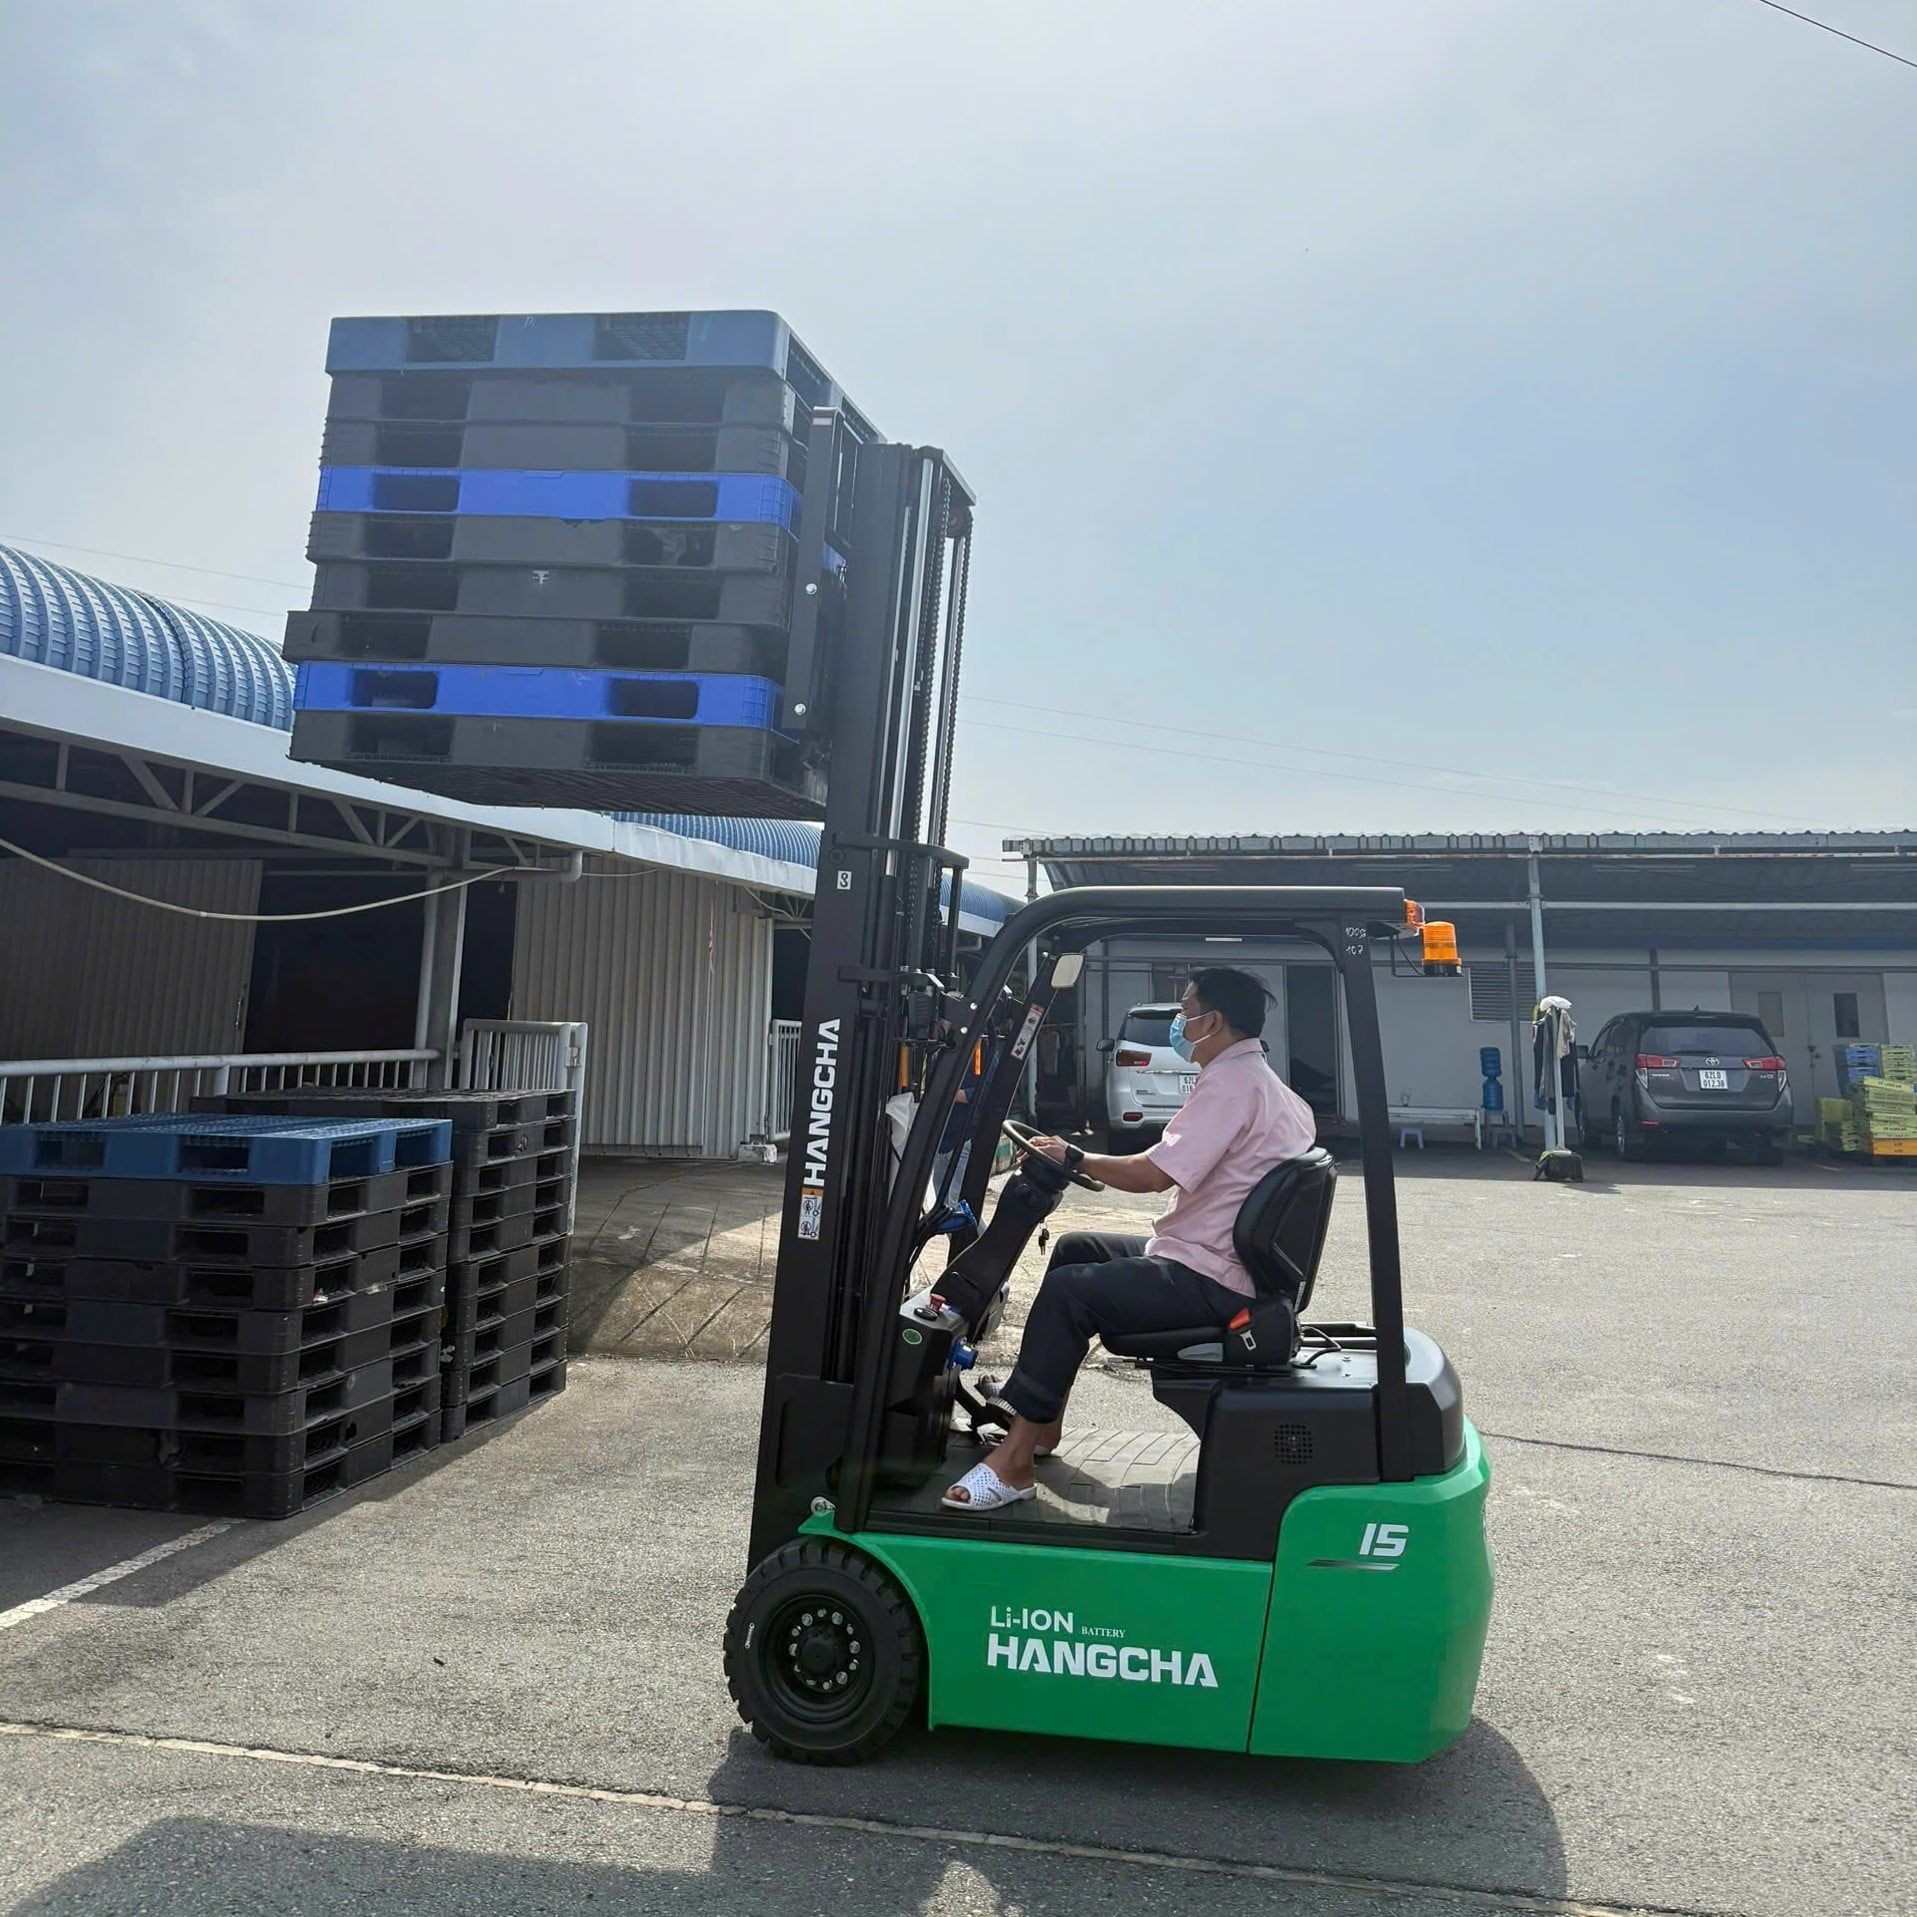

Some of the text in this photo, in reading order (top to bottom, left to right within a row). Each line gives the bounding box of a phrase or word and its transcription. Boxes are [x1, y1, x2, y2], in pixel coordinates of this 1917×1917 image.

[803, 1018, 841, 1187] HANGCHA
[1359, 1523, 1410, 1557] 15
[1081, 1626, 1126, 1638] BATTERY
[987, 1633, 1219, 1688] HANGCHA
